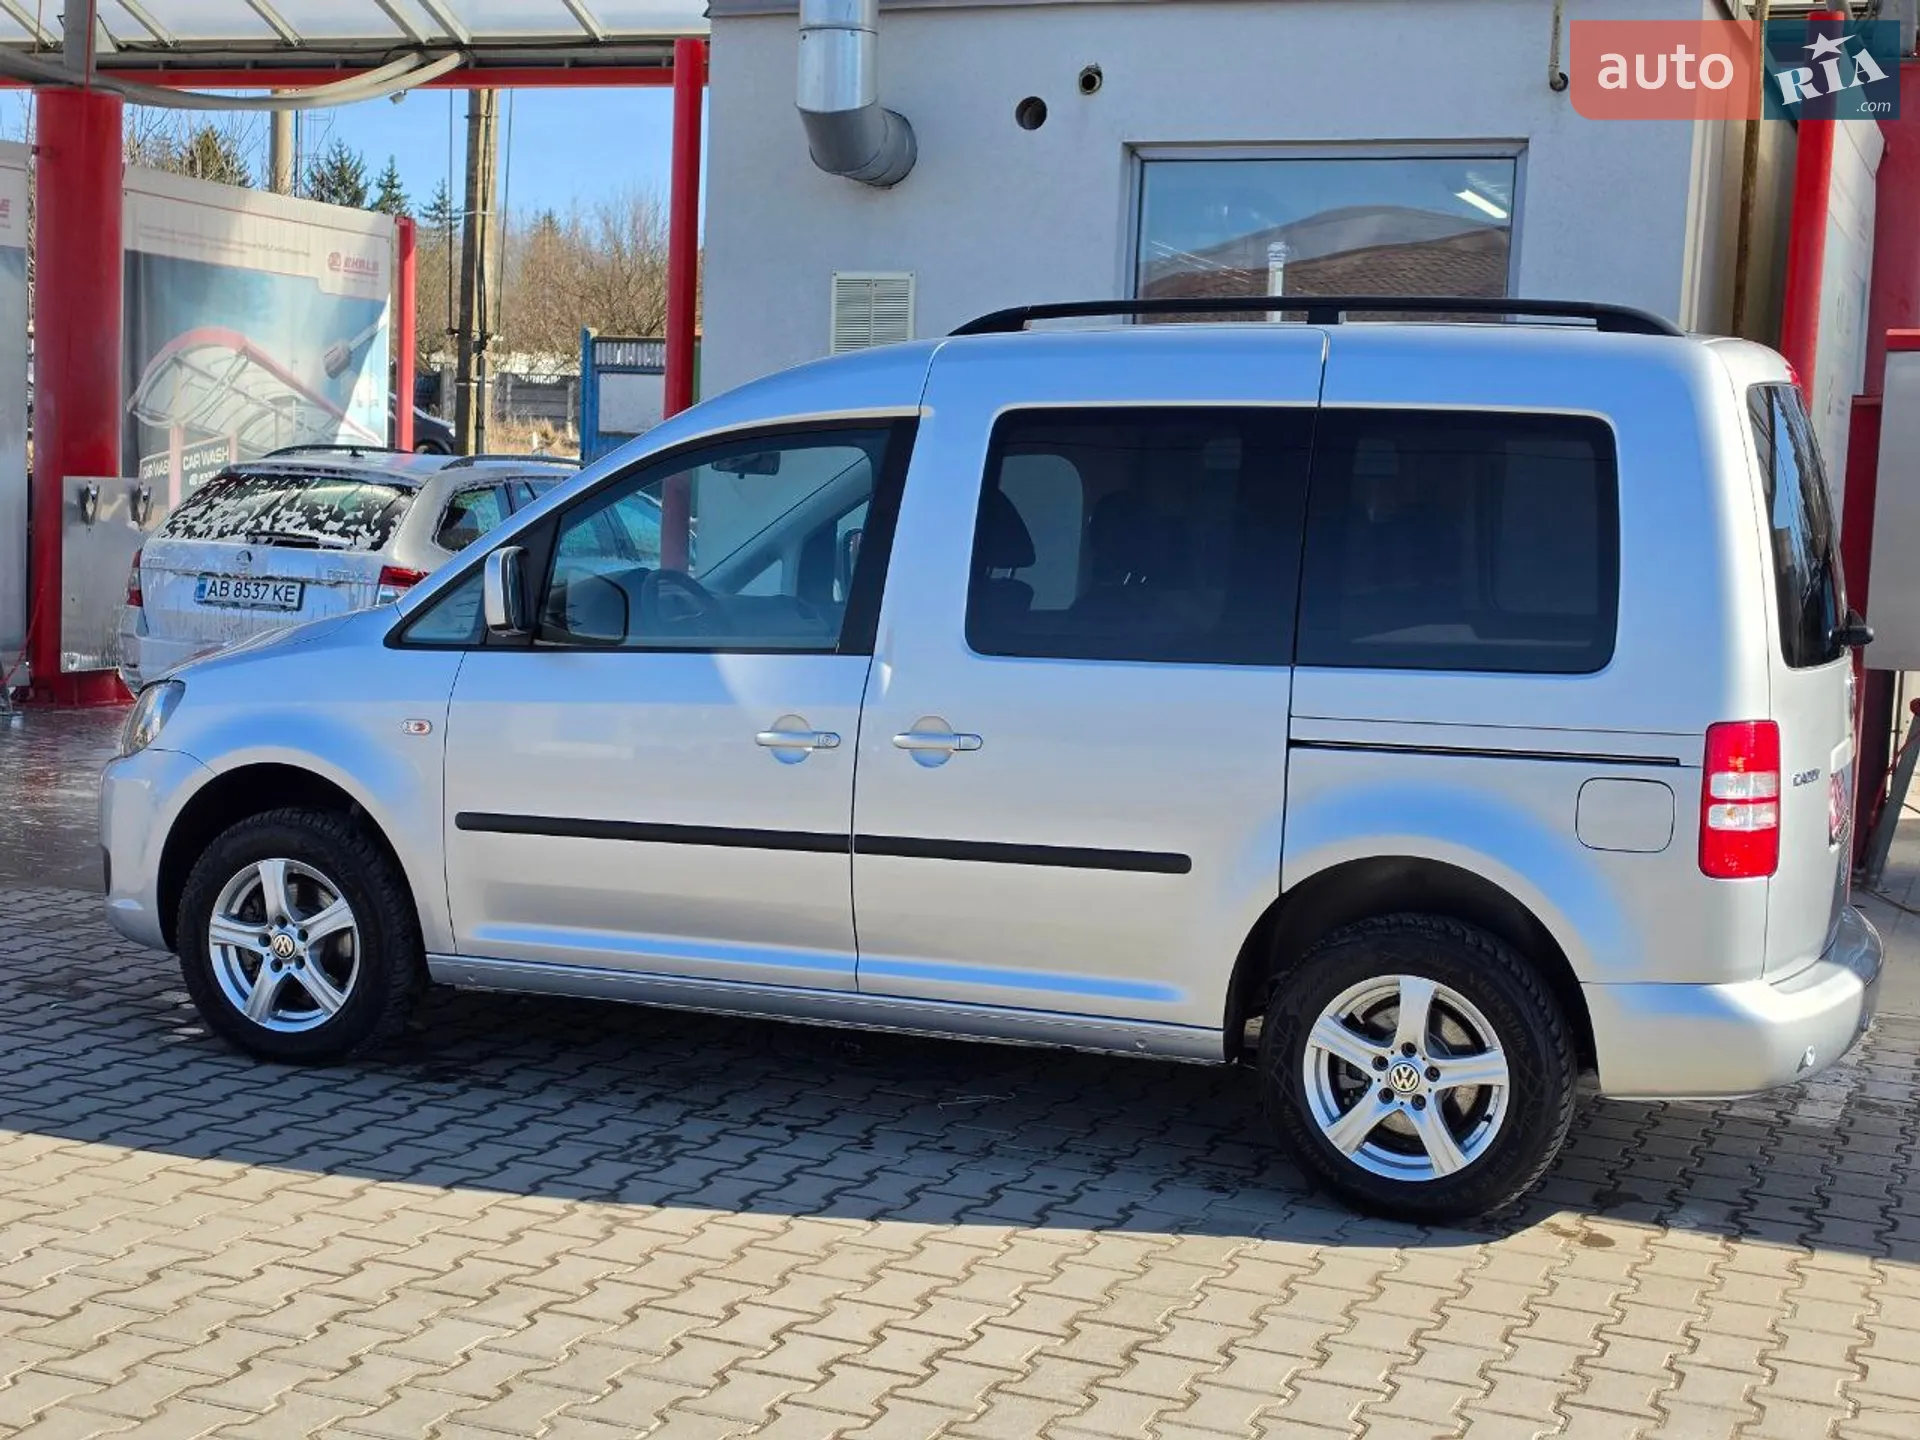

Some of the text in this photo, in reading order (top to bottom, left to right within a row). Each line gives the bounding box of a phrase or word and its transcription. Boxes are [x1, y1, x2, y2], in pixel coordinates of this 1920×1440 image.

[183, 446, 229, 471] CAR WASH
[207, 580, 296, 603] AB 8537 KE
